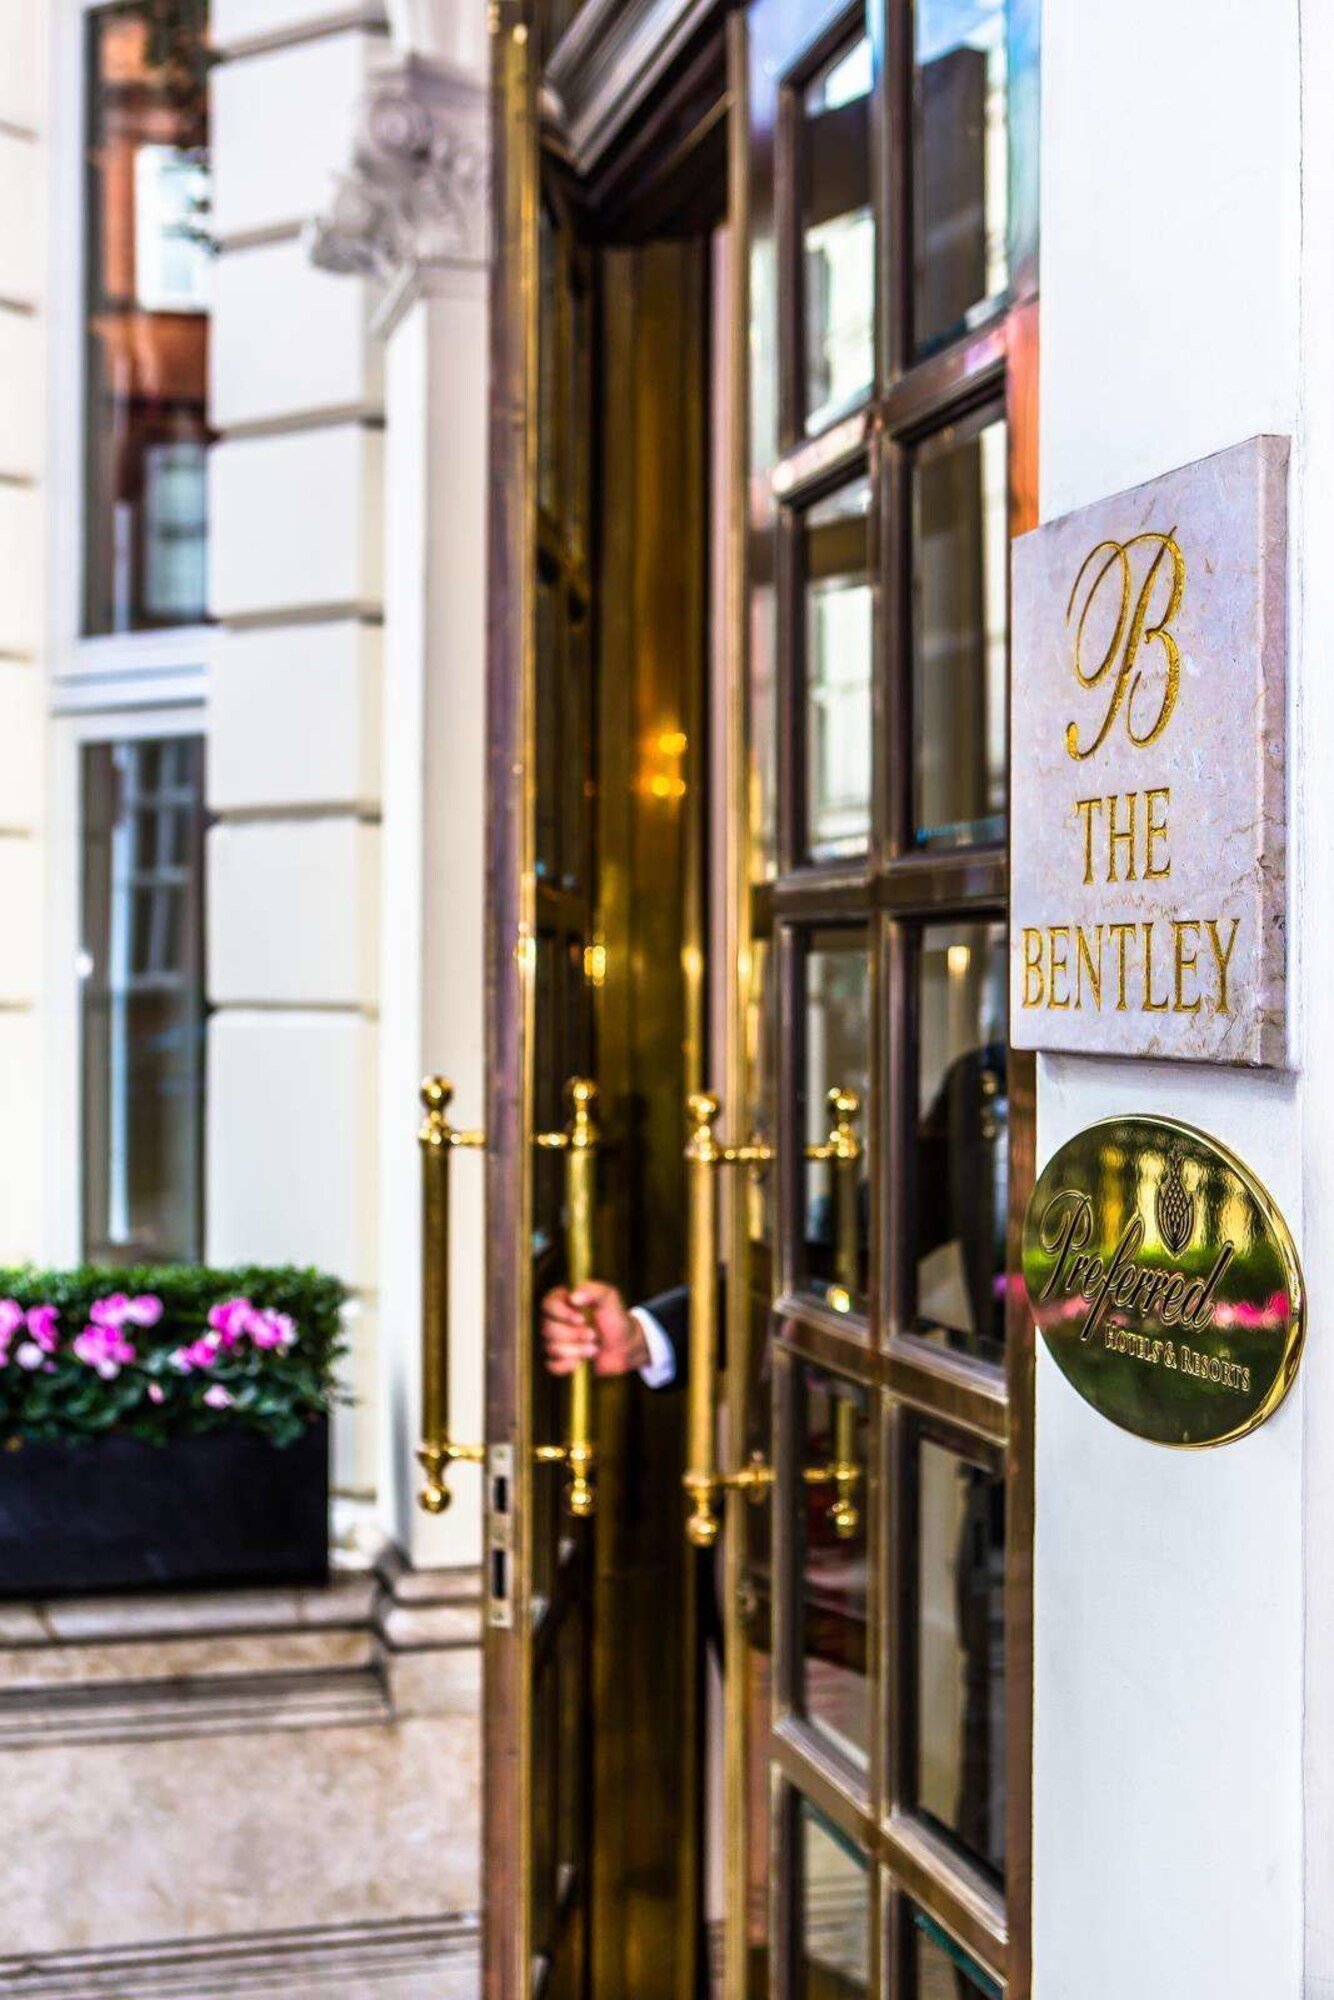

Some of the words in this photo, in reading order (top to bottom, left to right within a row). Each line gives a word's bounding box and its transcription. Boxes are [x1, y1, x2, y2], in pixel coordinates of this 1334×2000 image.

[1065, 525, 1186, 762] B
[1076, 787, 1172, 886] THE
[1021, 918, 1241, 1014] BENTLEY
[1040, 1190, 1235, 1341] Preferred
[1104, 1323, 1162, 1364] HOTELS
[1163, 1341, 1178, 1369] &
[1181, 1345, 1250, 1392] RESORTS
